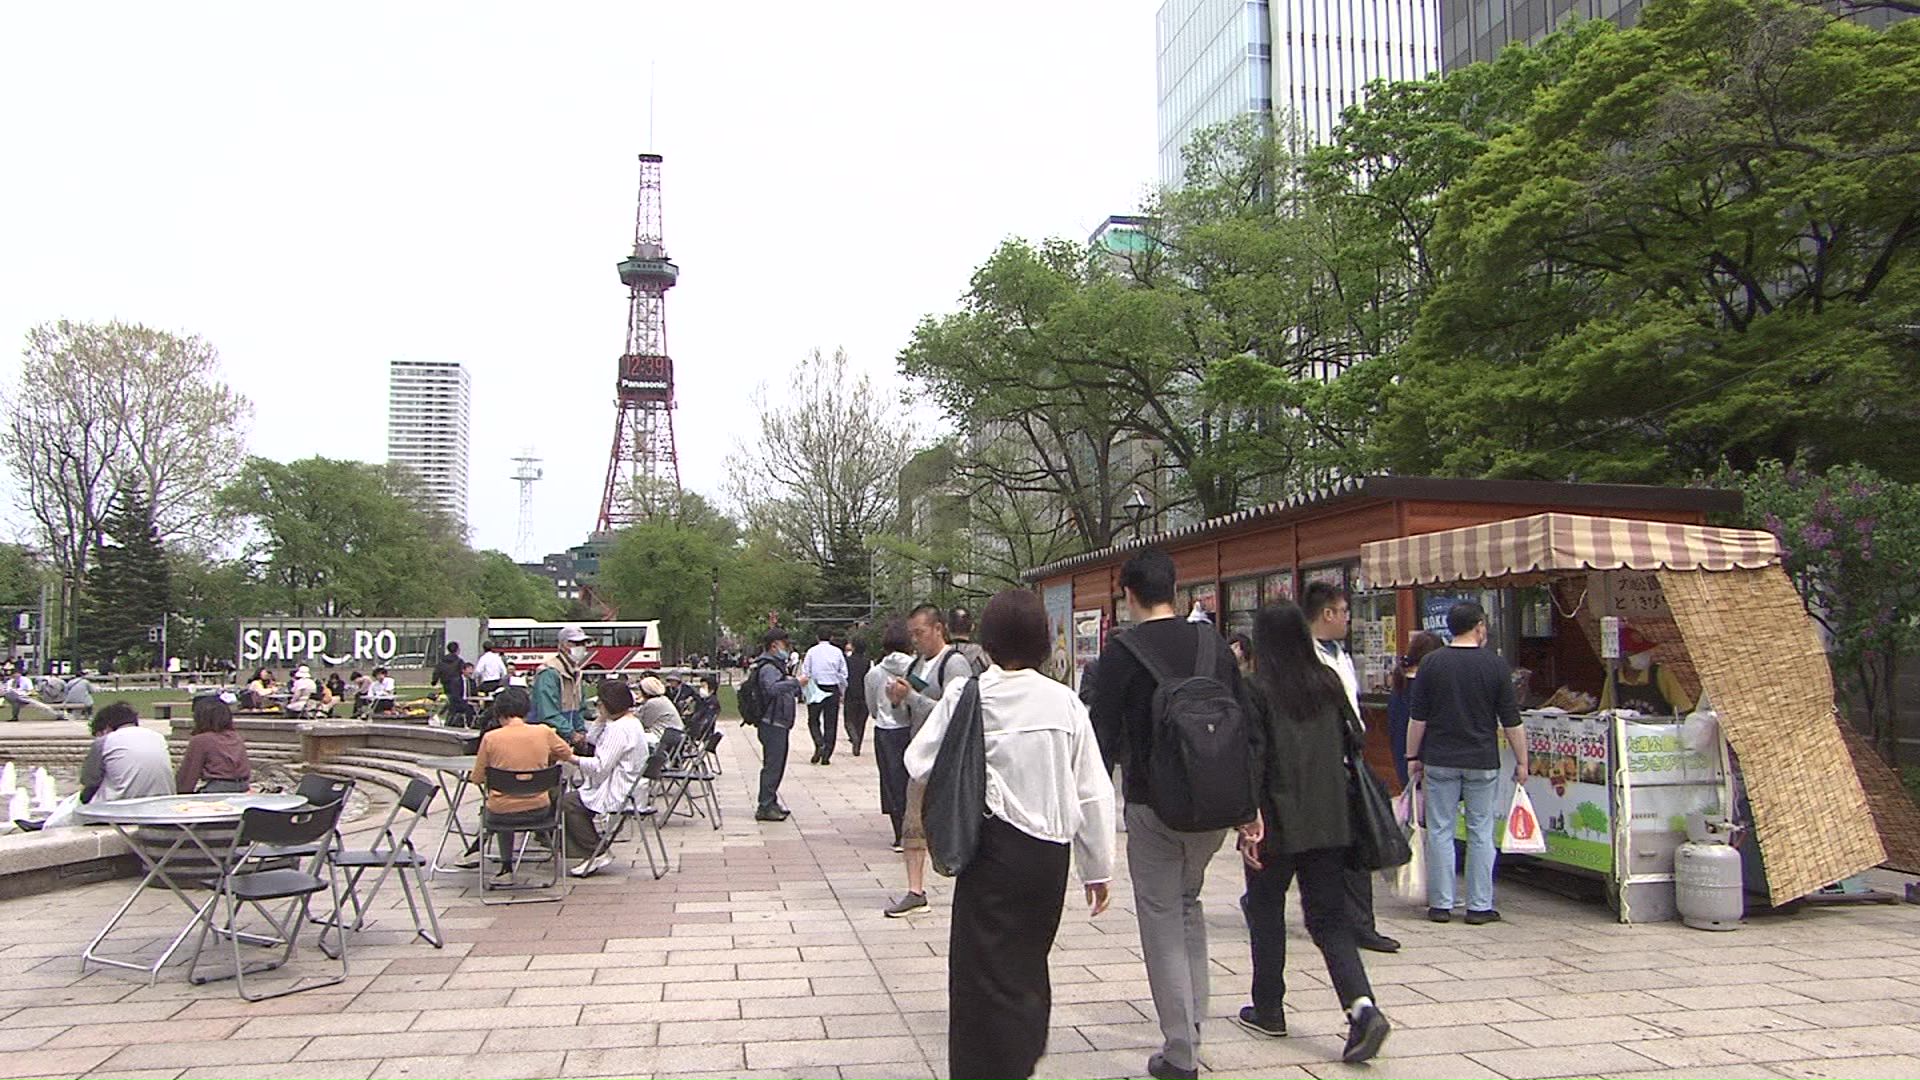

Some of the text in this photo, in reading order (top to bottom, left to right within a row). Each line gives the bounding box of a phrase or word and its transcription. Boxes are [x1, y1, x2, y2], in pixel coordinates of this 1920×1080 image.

[625, 356, 664, 376] 12:39
[621, 379, 667, 389] Panasonic
[1583, 744, 1605, 759] 300
